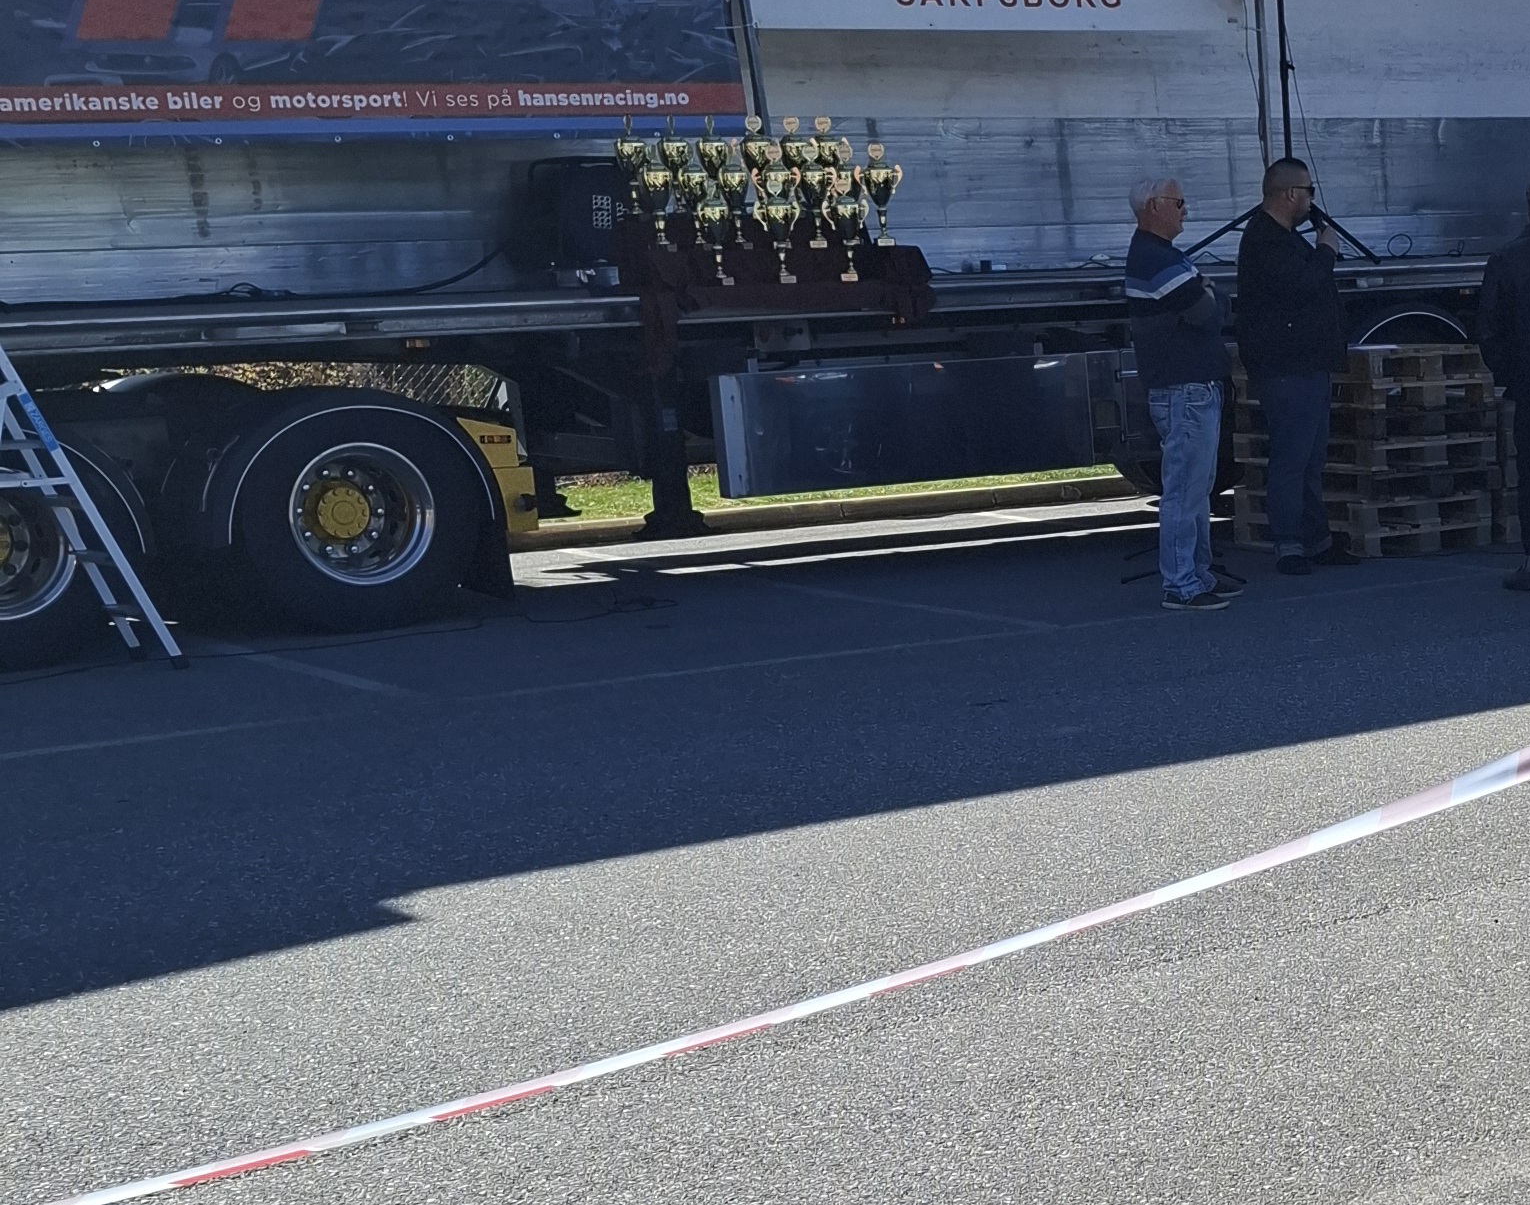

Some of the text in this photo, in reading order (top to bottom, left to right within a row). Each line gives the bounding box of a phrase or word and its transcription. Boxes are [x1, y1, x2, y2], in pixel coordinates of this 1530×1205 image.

[0, 88, 690, 112] amerikanske biler og motorsport! Vi ses på hansenracing.no
